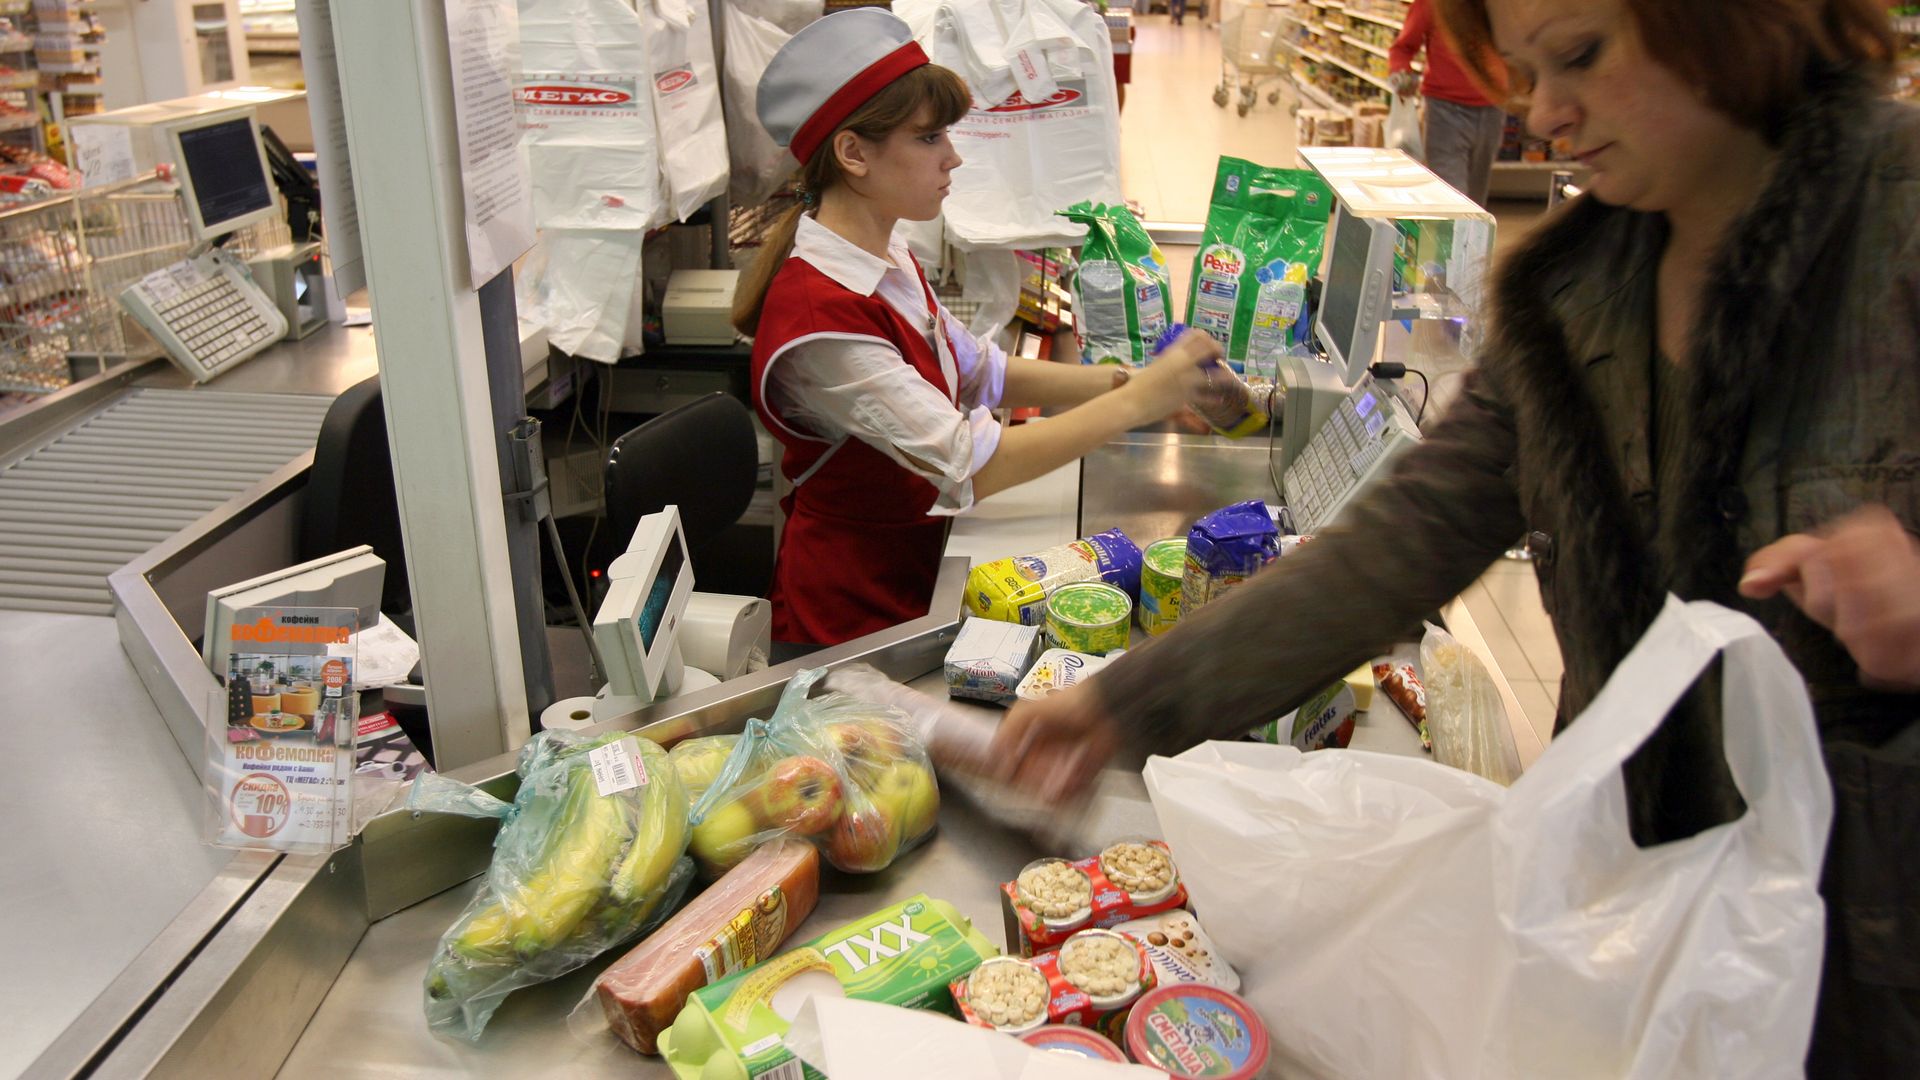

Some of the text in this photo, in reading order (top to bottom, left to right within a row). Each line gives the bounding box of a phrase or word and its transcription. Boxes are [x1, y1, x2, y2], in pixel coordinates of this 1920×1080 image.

[515, 87, 619, 103] МЕГАС
[1203, 253, 1241, 275] Persil
[824, 914, 931, 974] XXL
[1149, 1012, 1206, 1077] СМЕТАНА
